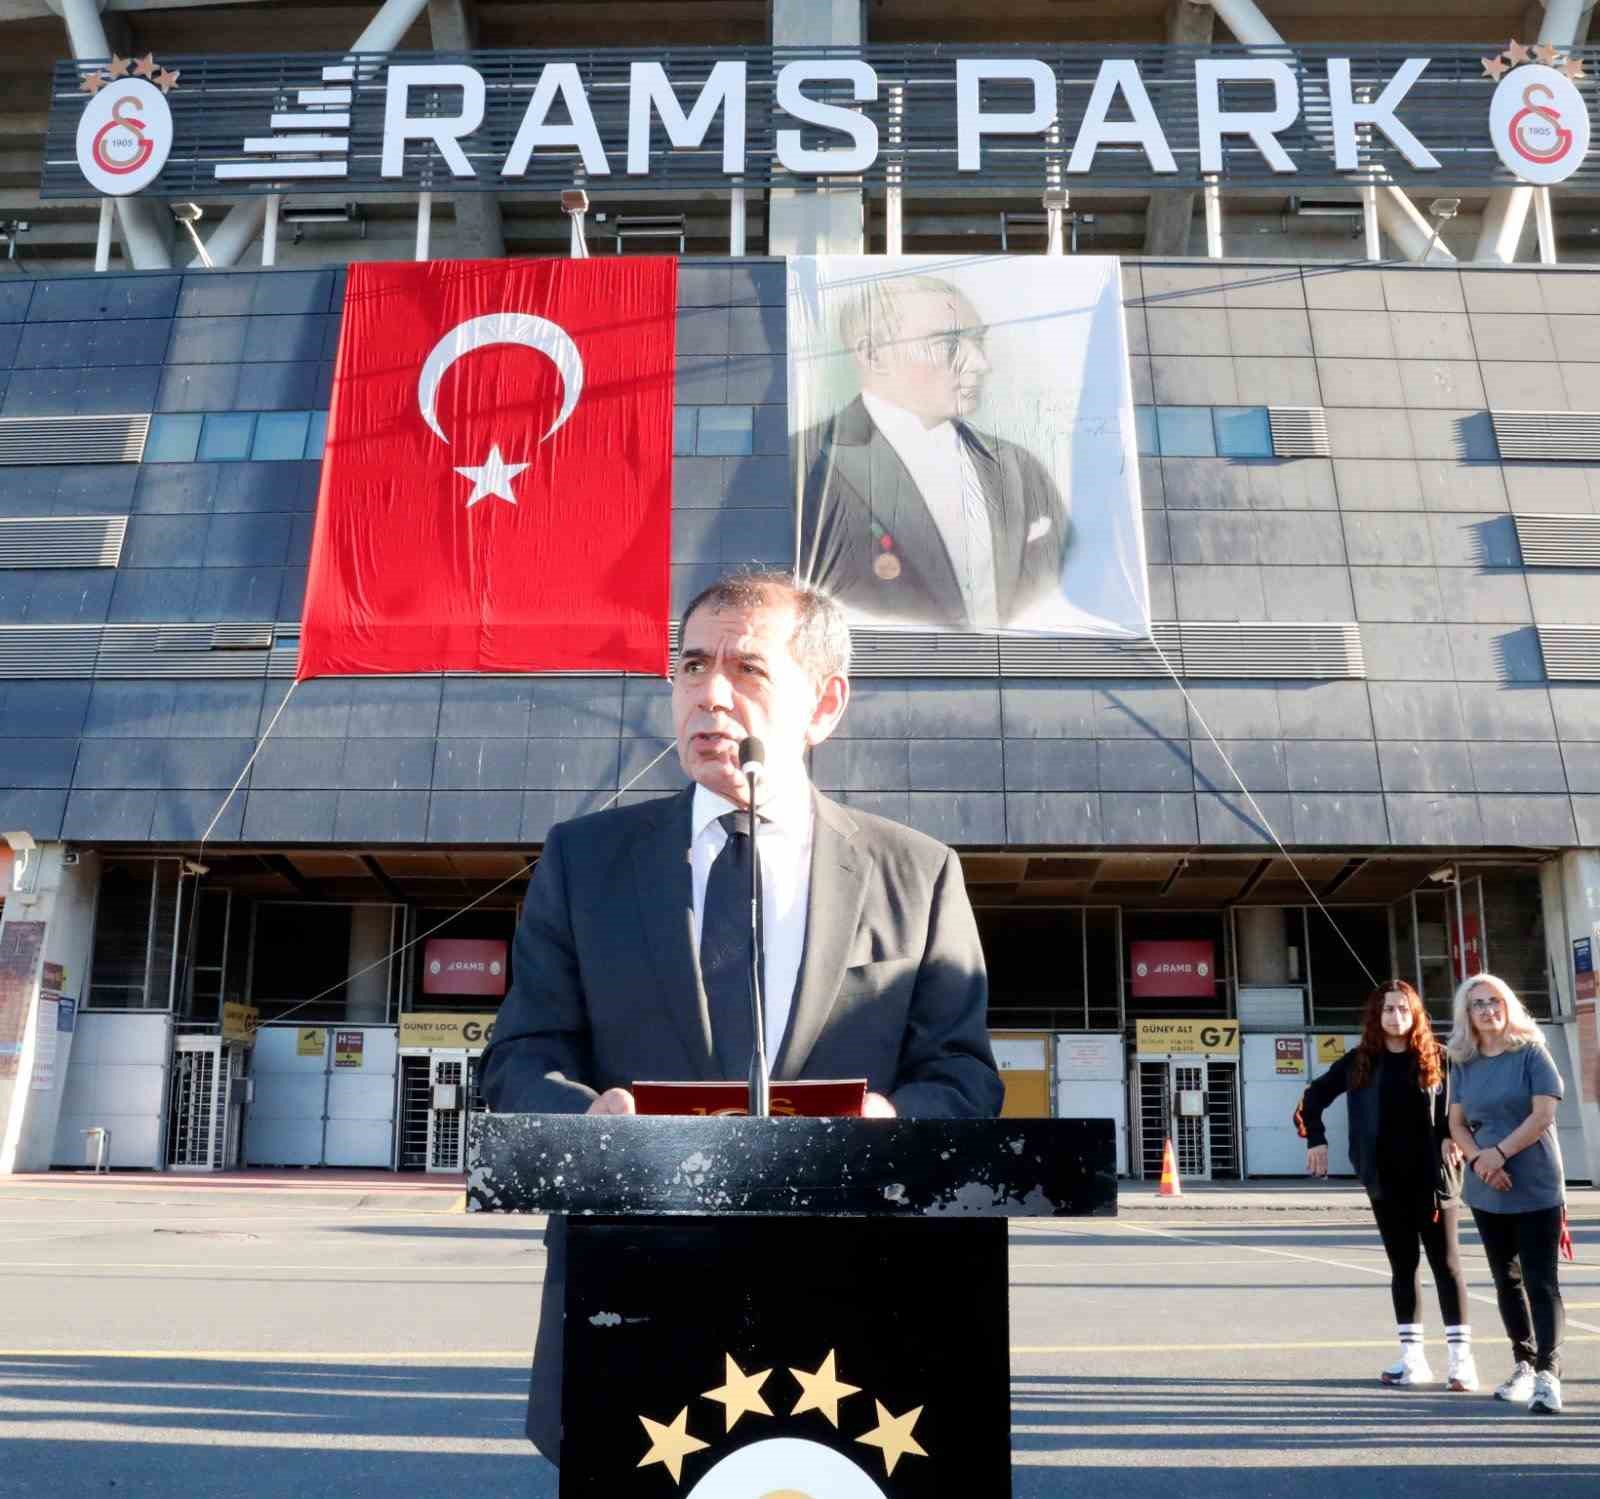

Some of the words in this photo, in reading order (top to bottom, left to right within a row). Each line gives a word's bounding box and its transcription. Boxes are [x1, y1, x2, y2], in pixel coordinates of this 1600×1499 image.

[380, 59, 879, 179] RAMS
[955, 57, 1442, 175] PARK
[1528, 127, 1551, 136] 1905
[112, 138, 133, 147] 1905
[1162, 963, 1193, 973] RAMS
[1177, 1025, 1193, 1034] ALT
[1200, 1026, 1237, 1047] G7
